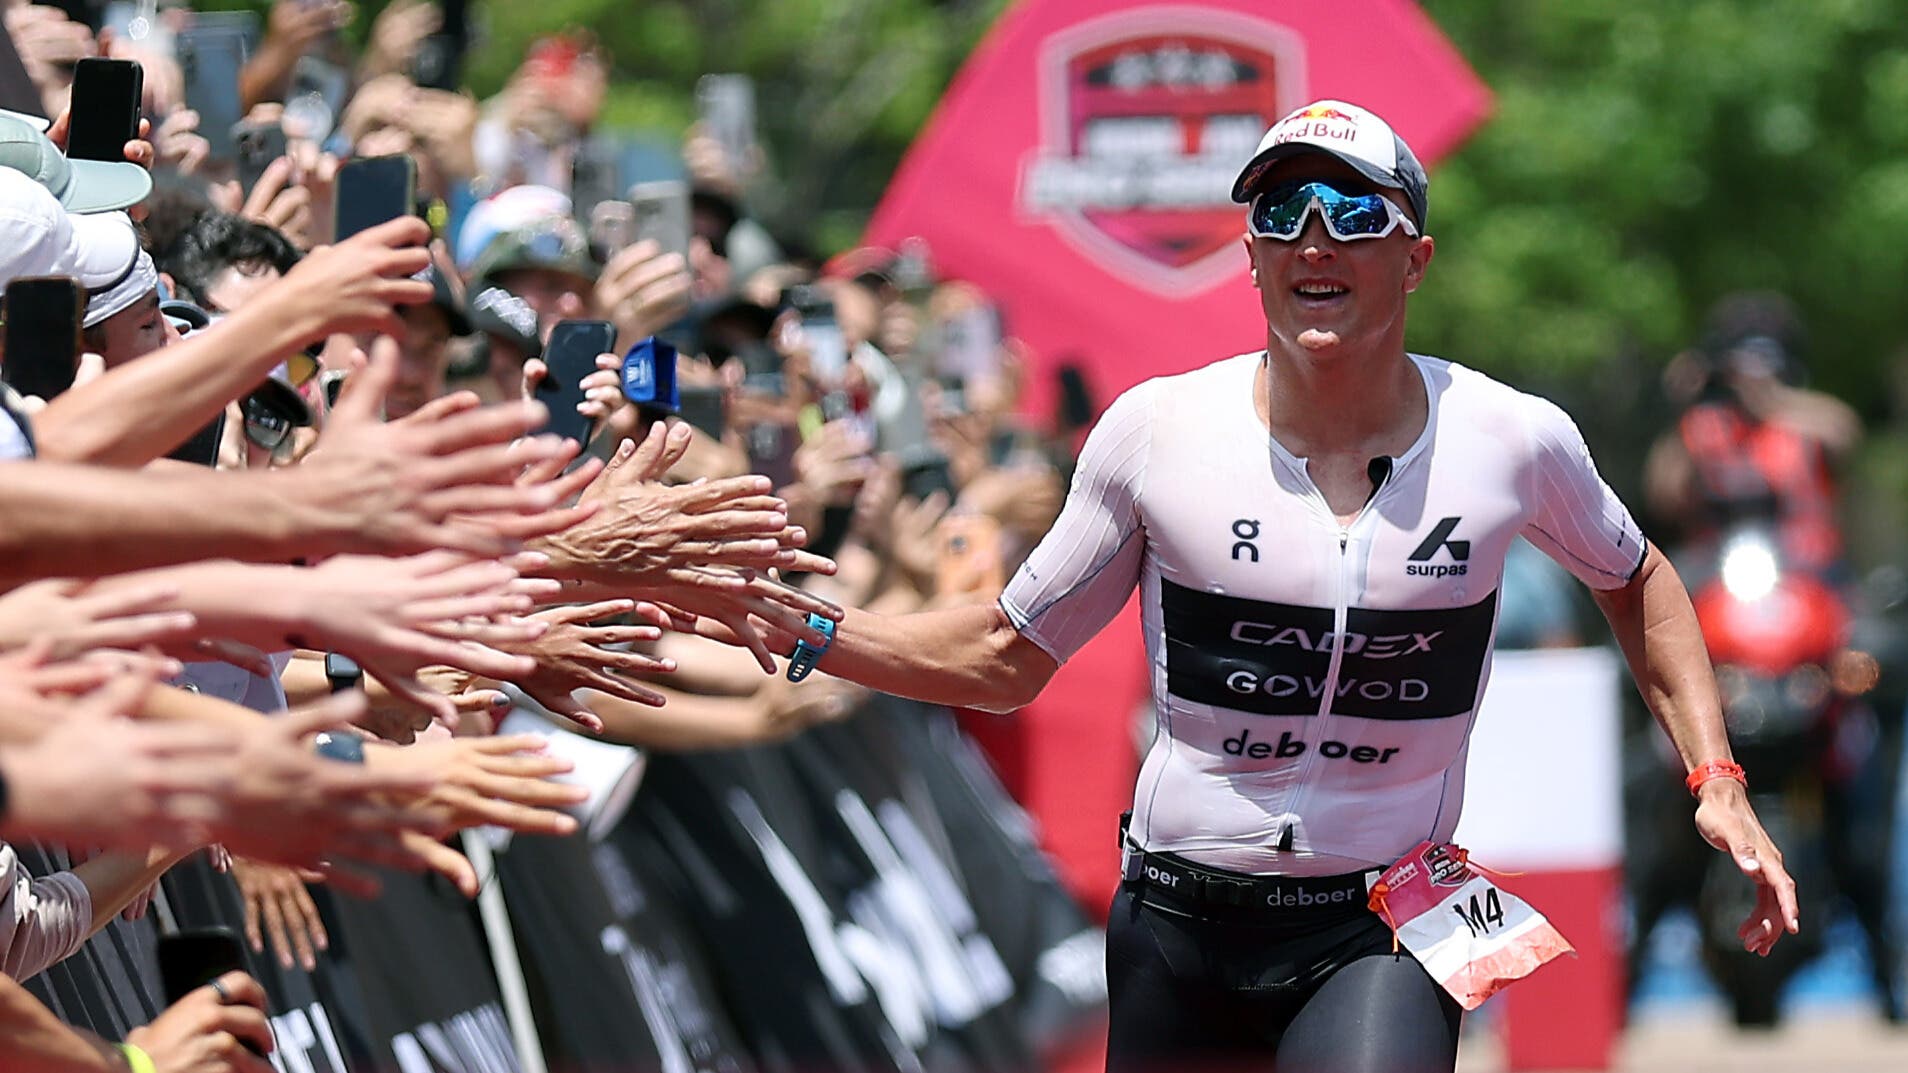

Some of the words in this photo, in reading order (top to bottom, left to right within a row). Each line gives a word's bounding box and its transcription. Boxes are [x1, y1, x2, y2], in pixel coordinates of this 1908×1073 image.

[1274, 122, 1310, 145] Red
[1314, 123, 1356, 142] Bull
[1406, 564, 1467, 578] surpas
[1230, 621, 1443, 658] CADEX
[1226, 671, 1429, 701] GOWOD
[1267, 887, 1355, 907] deboer
[1453, 887, 1504, 938] M4
